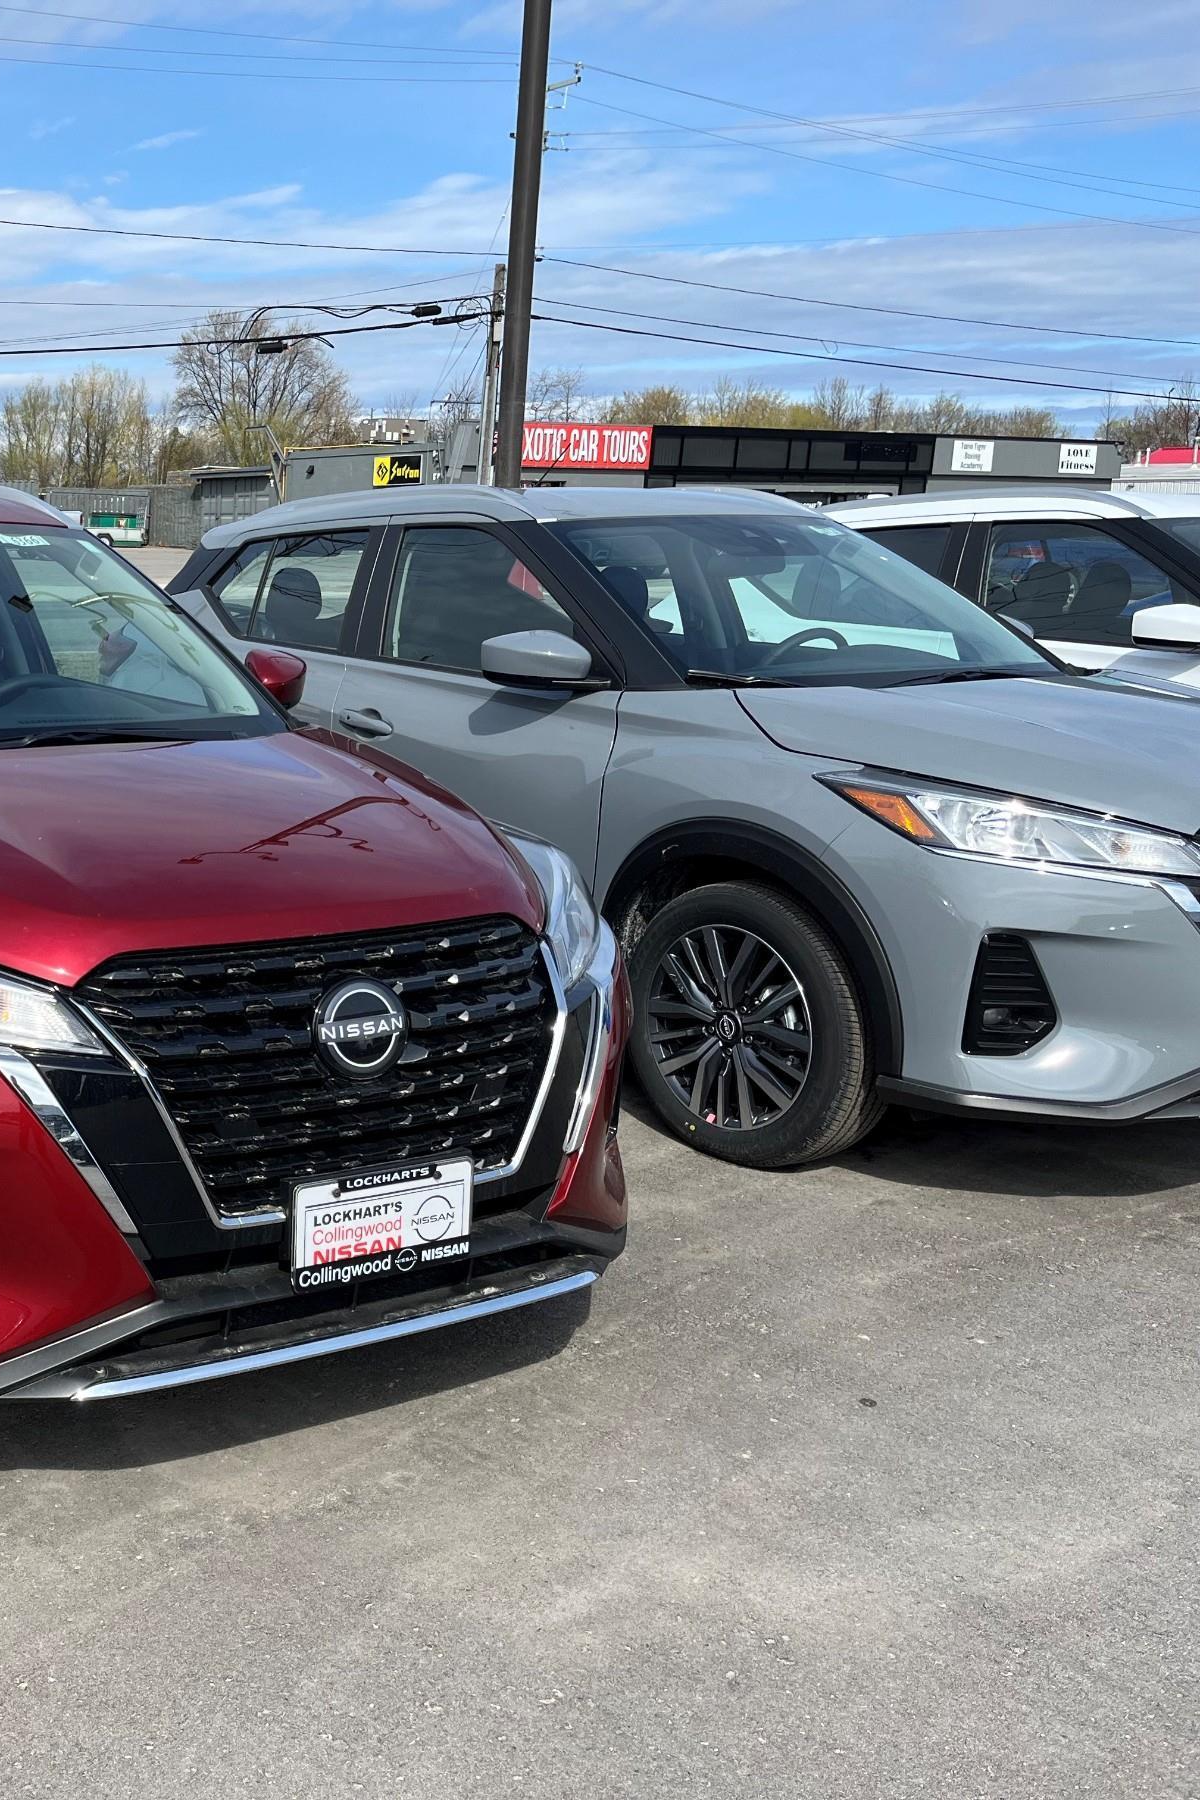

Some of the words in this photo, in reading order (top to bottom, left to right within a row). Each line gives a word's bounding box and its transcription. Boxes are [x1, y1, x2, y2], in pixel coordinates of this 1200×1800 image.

[522, 427, 567, 462] XOTIC
[569, 429, 599, 462] CAR
[602, 430, 649, 463] TOURS
[1067, 449, 1091, 457] LOVE
[1060, 460, 1094, 470] Fitness
[320, 1016, 403, 1041] NISSAN
[314, 1201, 402, 1227] LOCKHART'S
[411, 1211, 455, 1226] NISSAN
[313, 1216, 402, 1245] Collingwood
[299, 1254, 391, 1287] Collingwood
[421, 1242, 469, 1261] NISSAN
